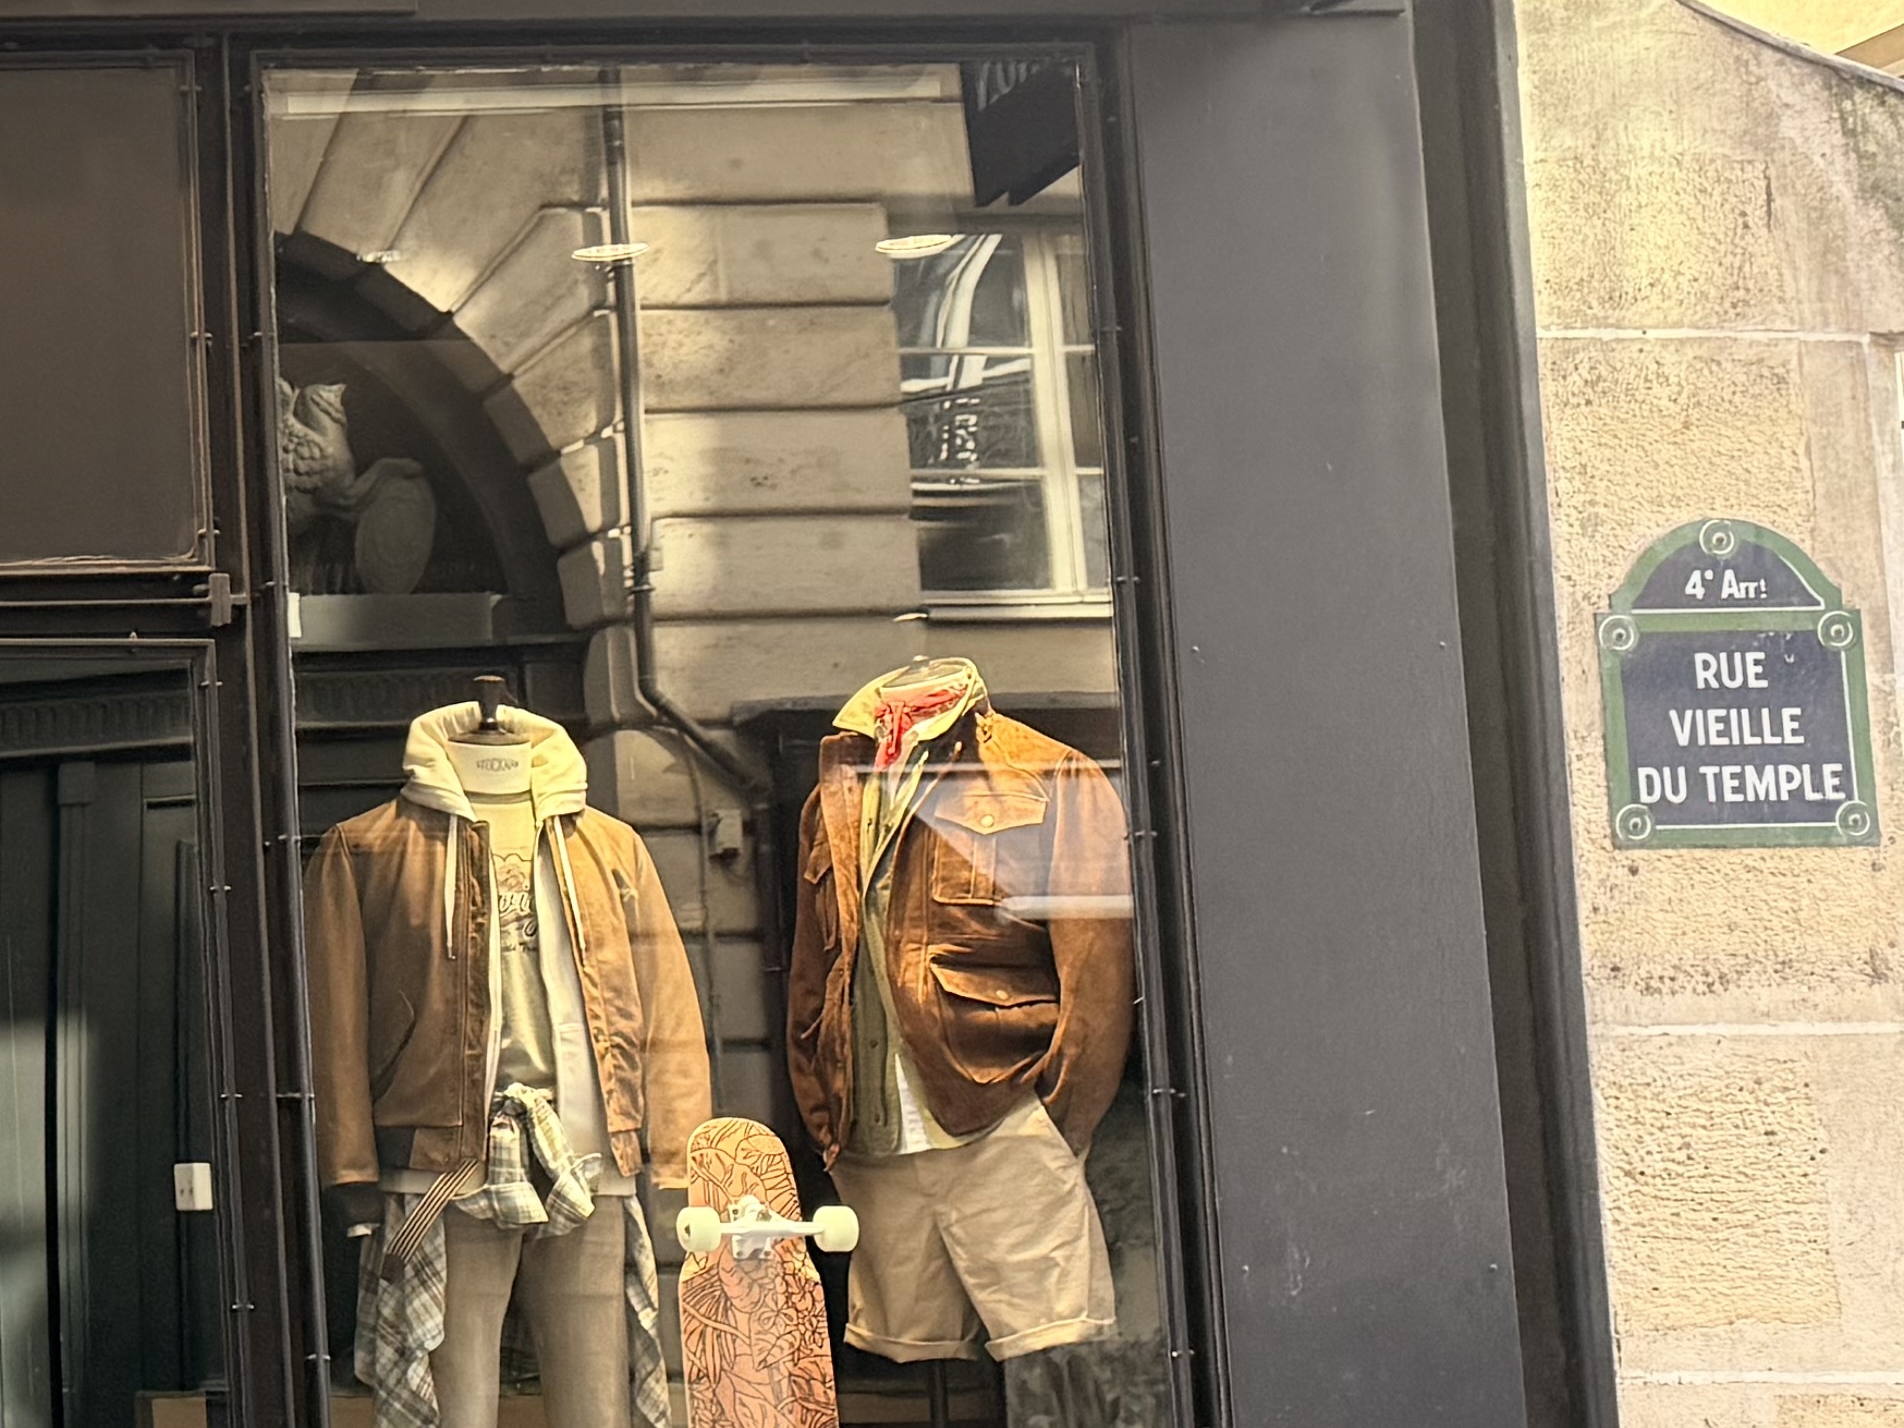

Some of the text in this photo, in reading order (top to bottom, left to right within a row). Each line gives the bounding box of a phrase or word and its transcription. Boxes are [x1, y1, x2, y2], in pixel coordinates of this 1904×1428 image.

[1694, 652, 1769, 690] RUE
[1669, 707, 1805, 747] VIEILLE
[1637, 763, 1846, 804] DU TEMPLE
